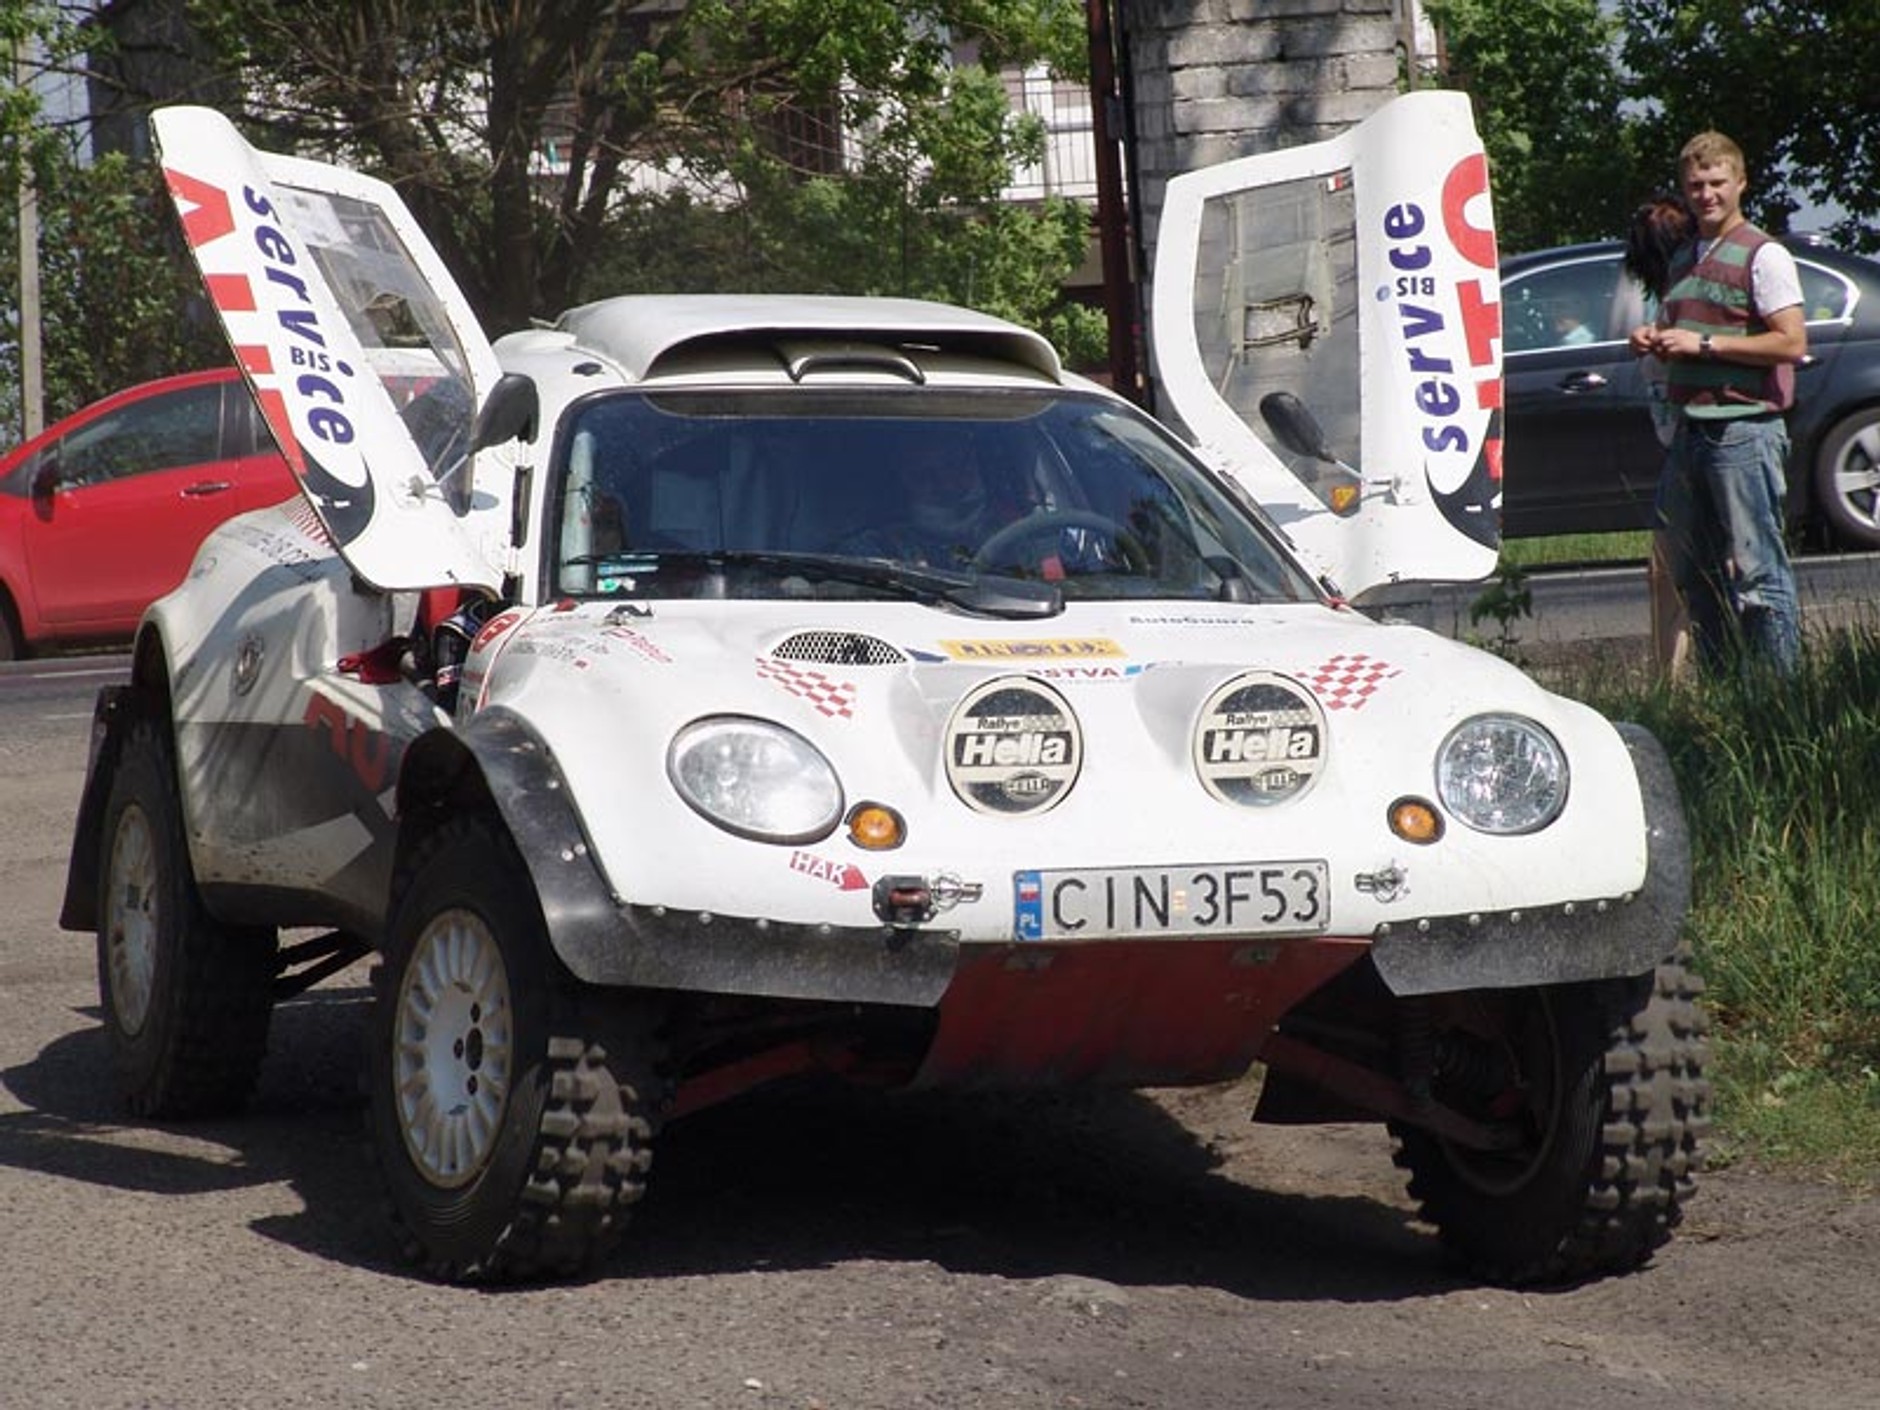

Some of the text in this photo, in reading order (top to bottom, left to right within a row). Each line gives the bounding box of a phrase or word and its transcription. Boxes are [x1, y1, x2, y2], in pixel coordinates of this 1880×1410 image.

[1396, 277, 1436, 297] BIS
[244, 184, 354, 446] service
[1376, 202, 1469, 454] service
[291, 345, 331, 373] BIS
[961, 733, 1067, 766] Hella
[1210, 729, 1313, 762] Hella
[790, 850, 846, 889] HAK
[1053, 868, 1321, 931] CIN 3F53
[1019, 914, 1039, 928] PL
